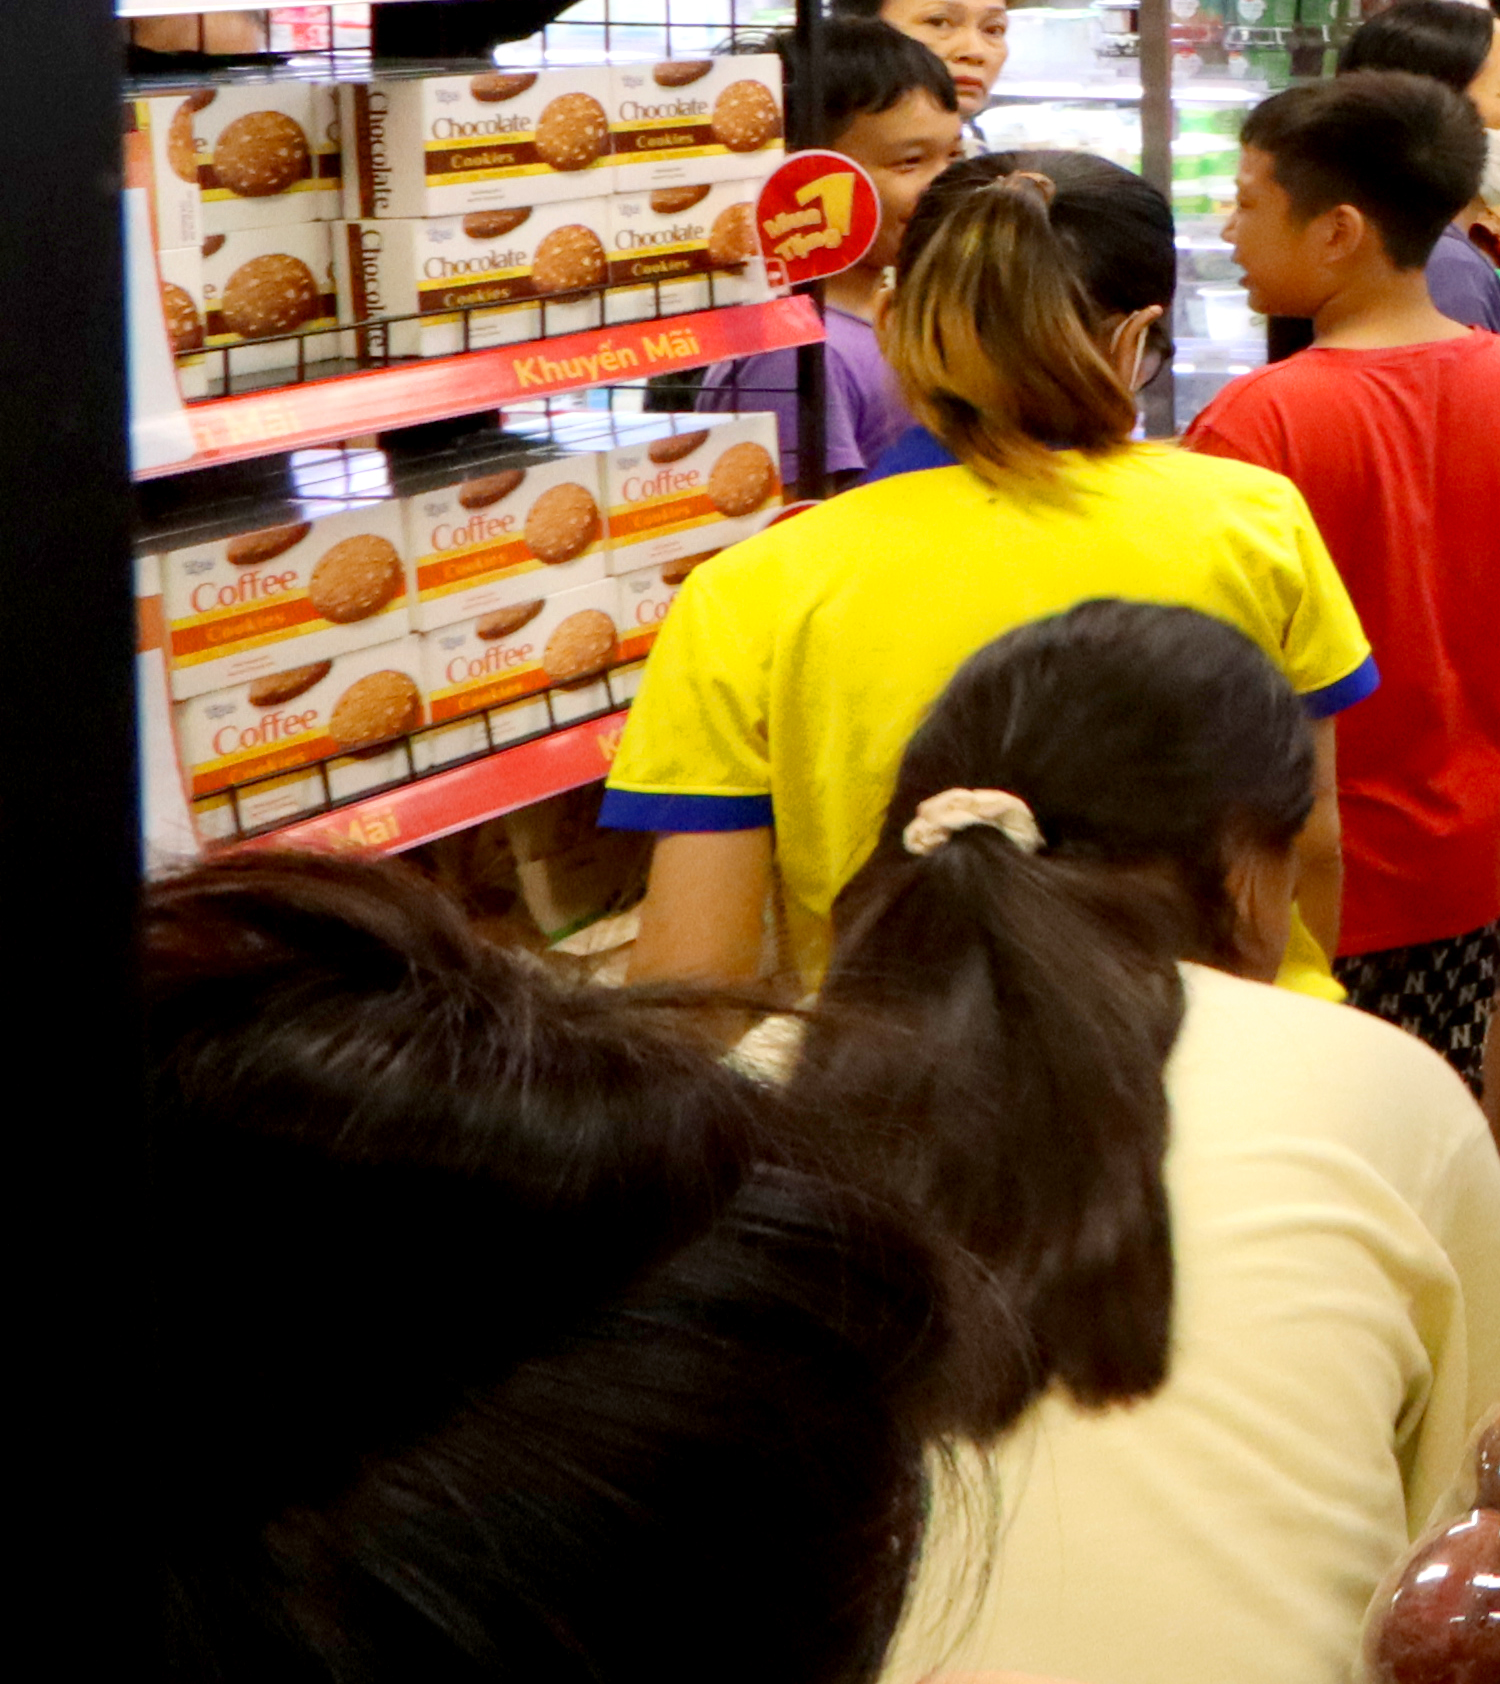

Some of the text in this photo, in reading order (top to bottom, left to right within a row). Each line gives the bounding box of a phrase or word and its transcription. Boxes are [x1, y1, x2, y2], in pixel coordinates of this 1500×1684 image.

[618, 97, 709, 122] Chocolate
[430, 112, 531, 142] Chocolate
[635, 132, 696, 149] Cookies
[369, 89, 392, 211] Chocolate
[450, 150, 516, 169] Cookies
[614, 221, 705, 252] Chocolate
[423, 248, 528, 281] Chocolate
[630, 257, 691, 277] Cookies
[443, 285, 512, 308] Cookies
[512, 327, 702, 388] Khuyến Mãi
[620, 466, 701, 504] Coffee
[430, 512, 517, 553] Coffee
[189, 567, 299, 615] Coffee
[444, 641, 535, 685] Coffee
[211, 707, 320, 758] Coffee
